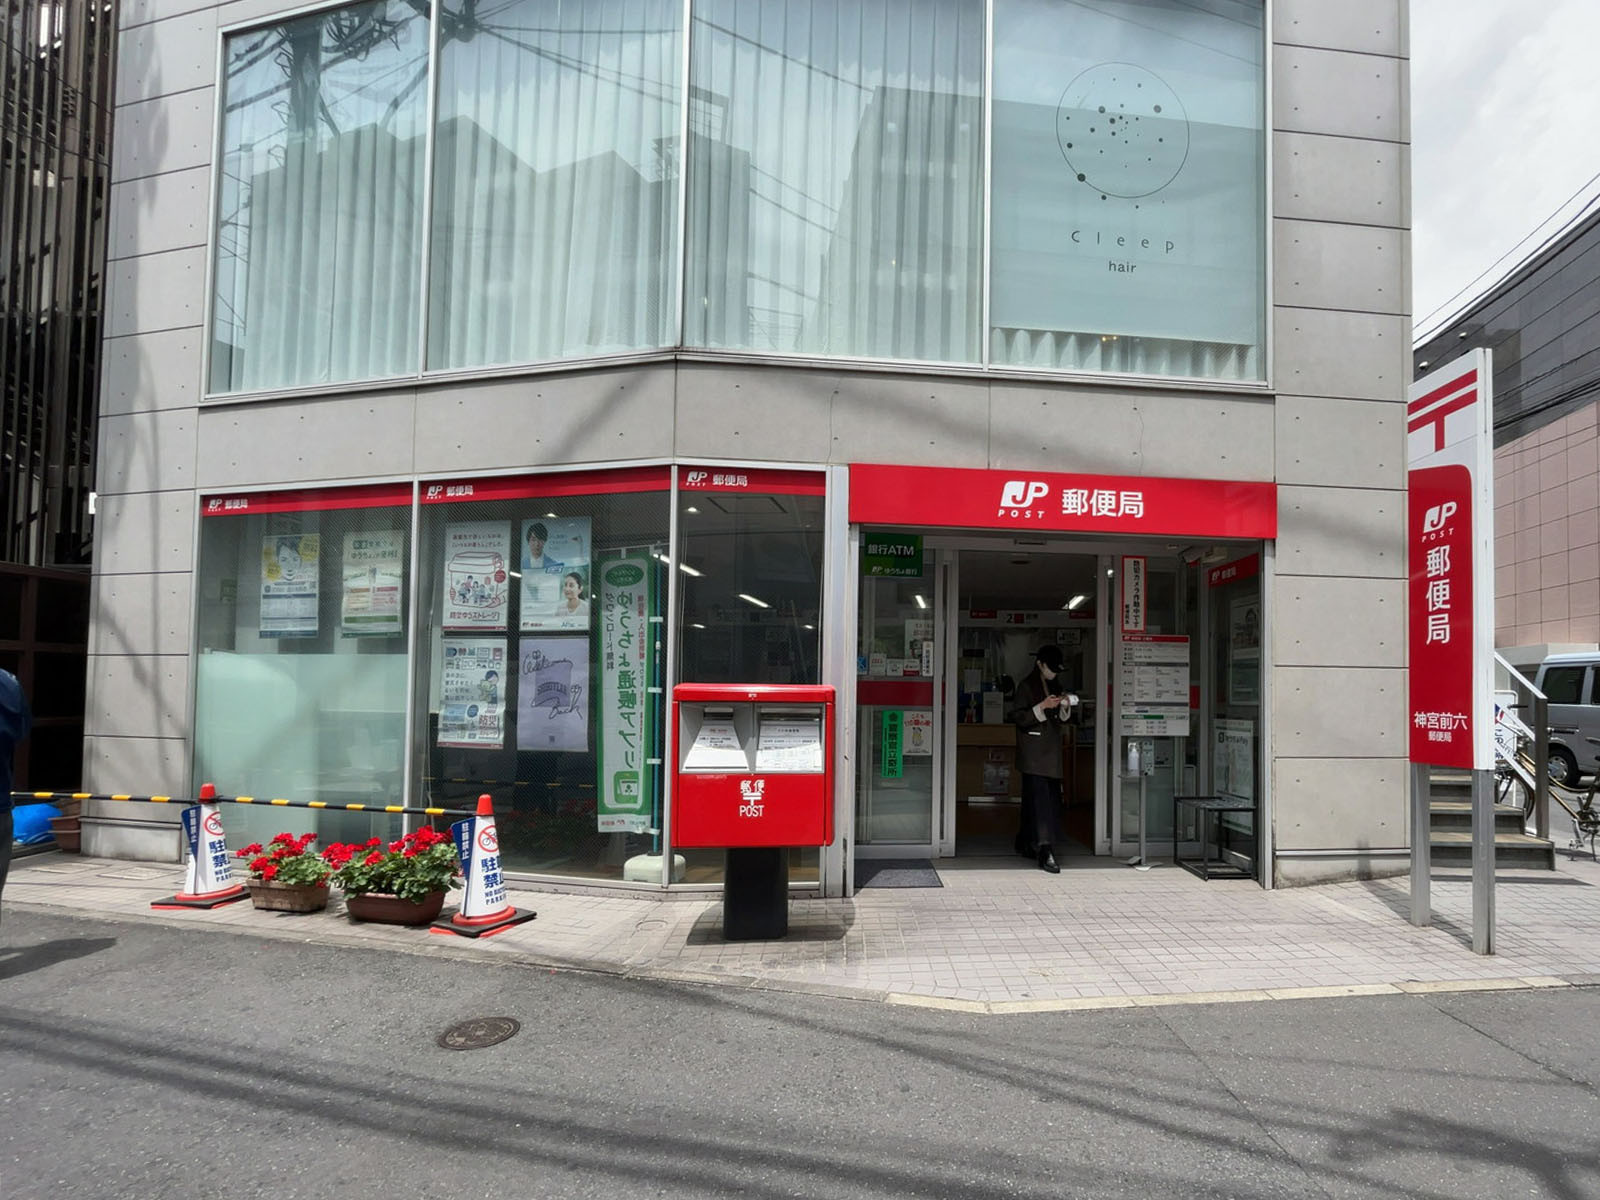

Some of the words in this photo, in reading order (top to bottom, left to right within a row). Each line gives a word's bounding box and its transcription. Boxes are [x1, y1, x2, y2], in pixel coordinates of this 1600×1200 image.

[1108, 260, 1137, 273] hair
[712, 474, 748, 487] 郵便局
[446, 485, 474, 497] 郵便局
[1000, 481, 1049, 508] JP
[1062, 488, 1144, 519] 郵便局
[998, 509, 1045, 519] POST
[1423, 501, 1457, 533] JP
[1421, 528, 1454, 542] POST
[868, 544, 914, 556] 銀行ATM
[884, 567, 918, 575] ゆうちょ銀行
[1425, 545, 1451, 645] 郵便局
[1414, 711, 1468, 730] 神宮前六
[1428, 731, 1452, 743] 郵便局
[740, 779, 765, 794] 郵便
[739, 805, 765, 817] POST
